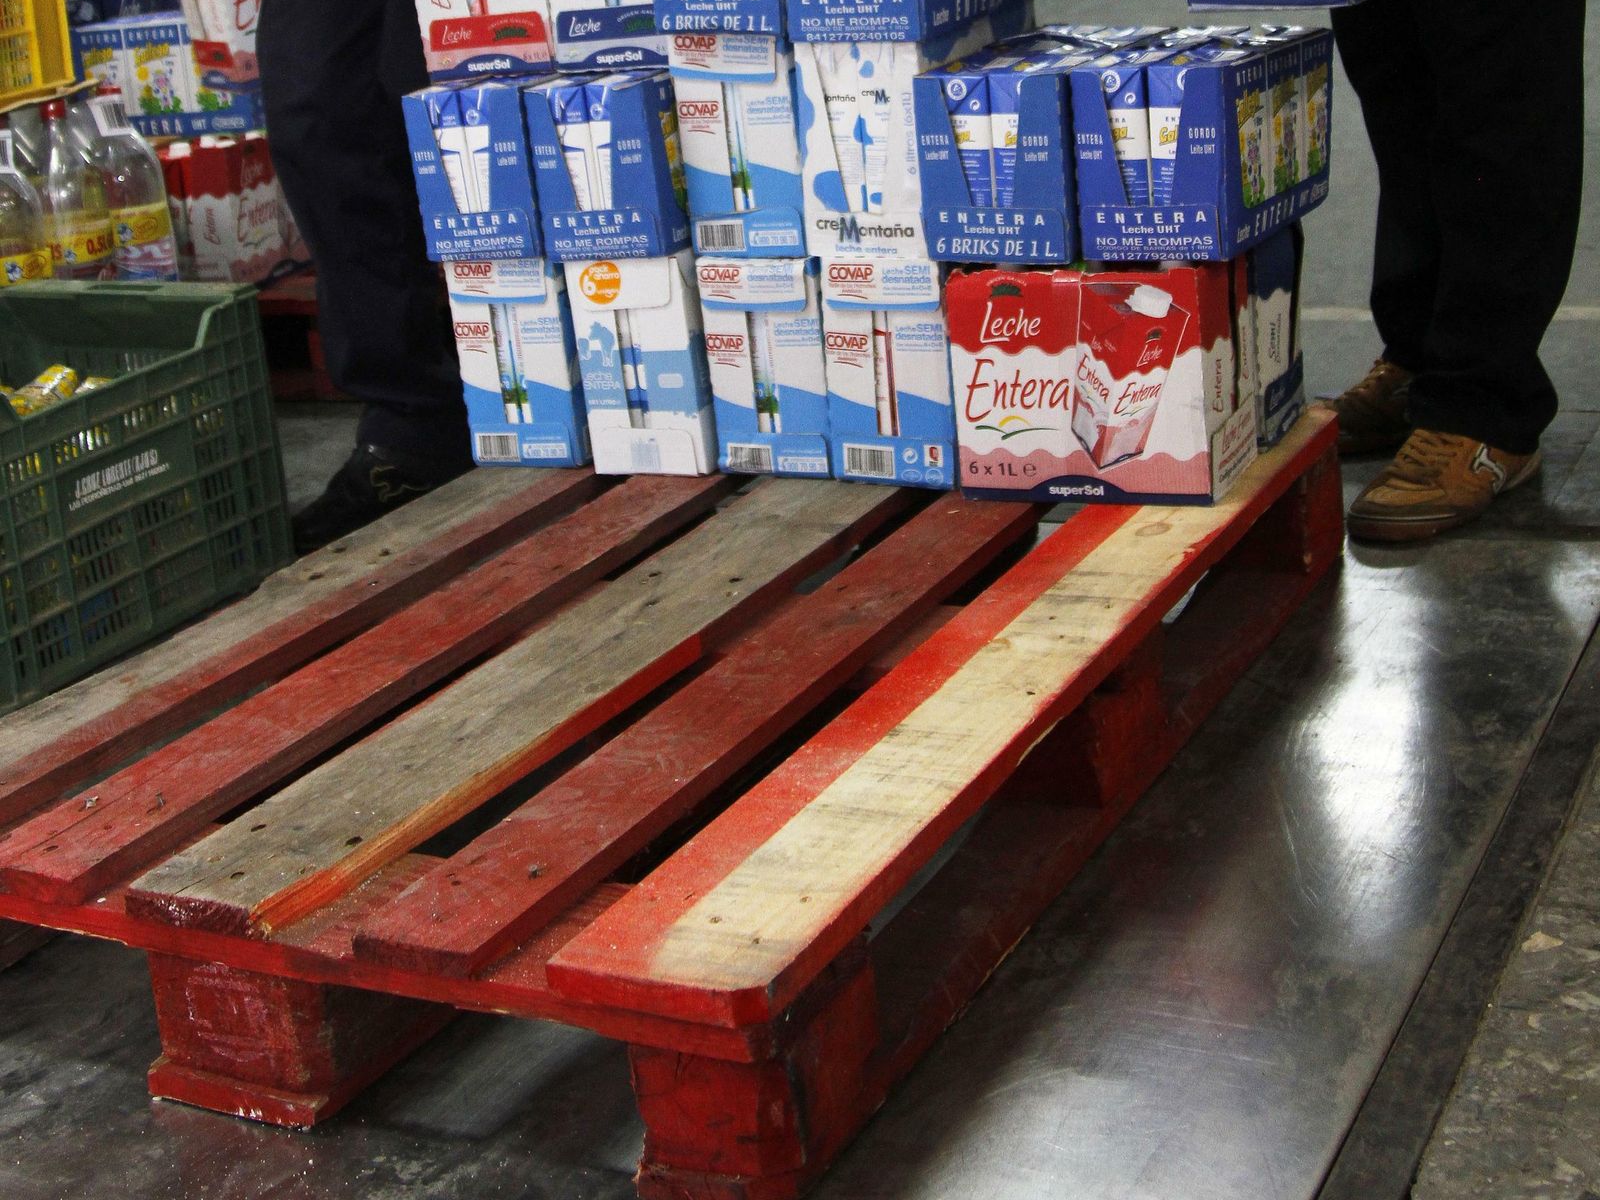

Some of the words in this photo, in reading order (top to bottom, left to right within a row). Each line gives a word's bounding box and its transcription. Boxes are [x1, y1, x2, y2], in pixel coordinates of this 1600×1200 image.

[685, 2, 714, 11] Leche
[716, 2, 738, 10] UHT
[825, 6, 855, 15] Leche
[857, 5, 880, 13] UHT
[569, 16, 601, 37] Leche
[662, 15, 670, 30] 6
[675, 15, 718, 31] BRIKS
[724, 15, 741, 31] DE
[748, 16, 754, 31] 1
[761, 16, 773, 31] L.
[801, 18, 820, 27] NO
[825, 18, 846, 26] ME
[849, 17, 909, 26] ROMPAS
[128, 30, 175, 43] ENTERA
[442, 25, 472, 45] Leche
[806, 32, 906, 41] 8412779240105
[674, 36, 716, 49] COVAP
[596, 51, 643, 65] superSol
[468, 59, 511, 72] superSol
[679, 104, 719, 116] COVAP
[1188, 127, 1216, 139] GORDO
[904, 129, 914, 162] litros
[921, 135, 949, 146] ENTERA
[1022, 136, 1049, 147] GORDO
[1077, 134, 1103, 145] ENTERA
[1204, 144, 1215, 155] UHT
[909, 166, 917, 175] 6
[434, 213, 517, 229] ENTERA
[553, 212, 641, 228] ENTERA
[939, 212, 1045, 225] ENTERA
[1096, 211, 1206, 224] ENTERA
[454, 229, 478, 237] Leche
[480, 226, 498, 234] UHT
[574, 228, 600, 236] Leche
[602, 226, 620, 234] UHT
[816, 215, 915, 243] creMontaña
[964, 226, 995, 234] Leche
[998, 226, 1021, 235] UHT
[1122, 226, 1154, 234] Leche
[1157, 225, 1181, 233] UHT
[436, 241, 451, 250] NO
[454, 239, 471, 248] ME
[473, 236, 524, 247] ROMPAS
[555, 240, 572, 248] NO
[575, 239, 592, 247] ME
[595, 235, 648, 246] ROMPAS
[937, 237, 945, 253] 6
[952, 238, 1000, 255] BRIKS
[1005, 240, 1024, 256] DE
[1030, 241, 1038, 256] 1
[1045, 241, 1058, 257] L.
[1096, 237, 1117, 246] NO
[1122, 237, 1143, 246] ME
[1147, 236, 1213, 246] ROMPAS
[835, 243, 862, 253] leche
[864, 245, 898, 255] entera
[1102, 252, 1209, 260] 8412779240105
[454, 265, 491, 276] COVAP
[700, 269, 739, 280] COVAP
[829, 267, 873, 280] COVAP
[904, 265, 930, 274] SEMI
[594, 272, 620, 280] ahorro
[882, 275, 931, 283] desnatada
[583, 274, 596, 296] 6
[793, 319, 819, 327] SEMI
[916, 324, 943, 332] SEMI
[980, 301, 1041, 343] Leche
[455, 325, 489, 336] COVAP
[774, 328, 819, 336] desnatada
[826, 335, 867, 349] COVAP
[895, 333, 943, 341] desnatada
[706, 337, 744, 350] COVAP
[1137, 344, 1163, 368] Leche
[1077, 353, 1110, 404] Entera
[964, 358, 1070, 423] Entera
[1213, 358, 1222, 413] Entera
[1113, 382, 1162, 415] Entera
[969, 462, 979, 475] 6
[984, 465, 993, 475] x
[999, 463, 1018, 476] 1L
[1049, 485, 1104, 496] superSol
